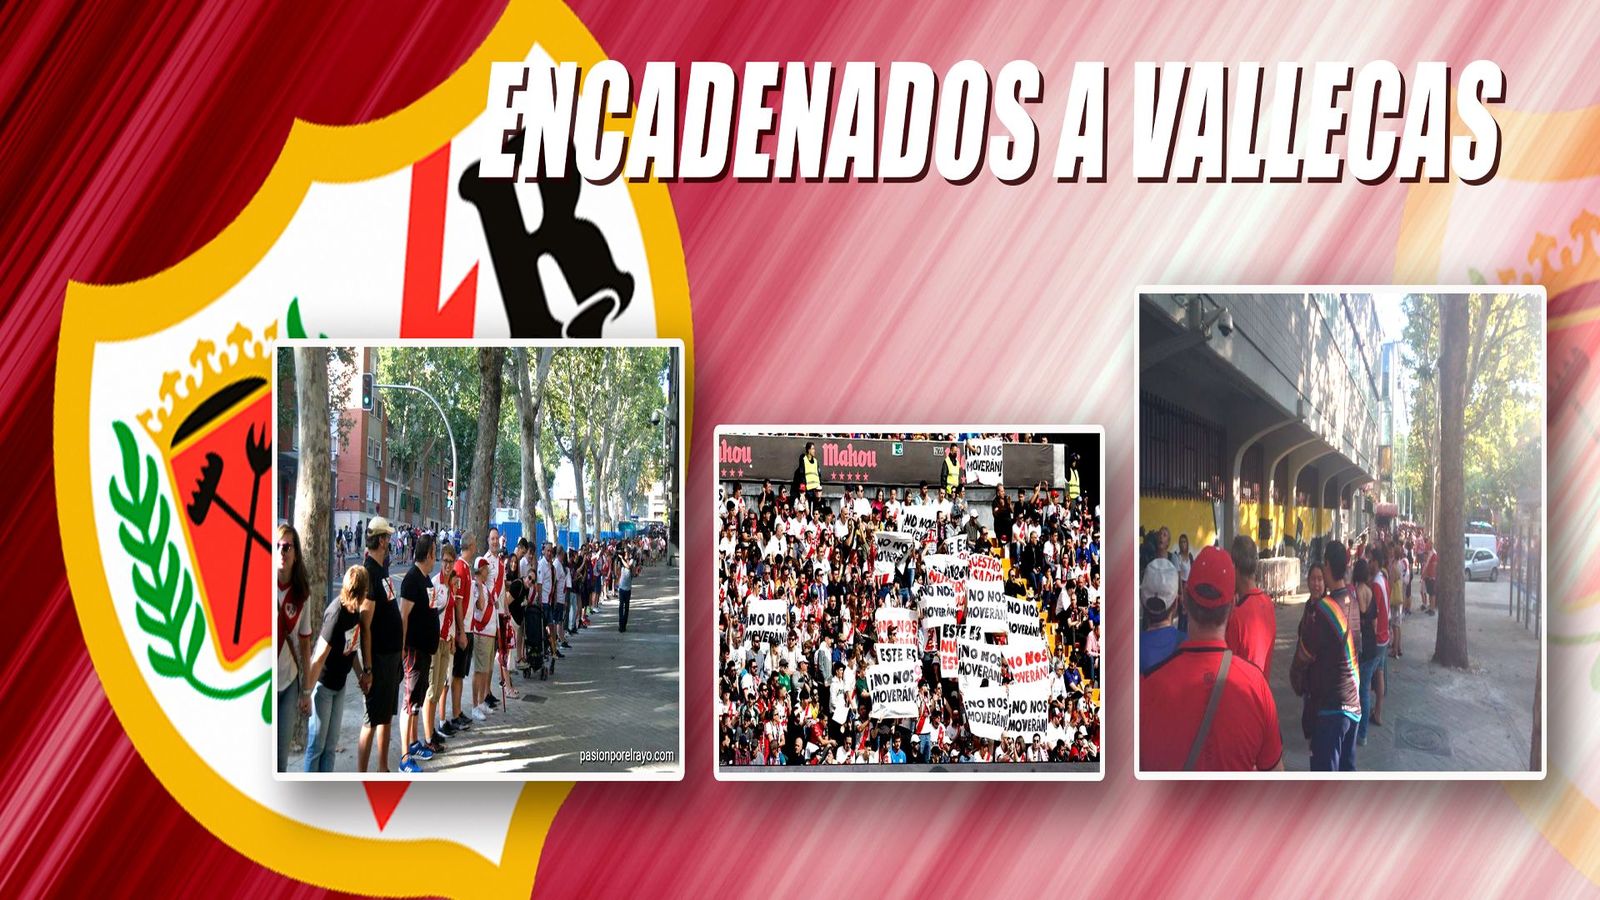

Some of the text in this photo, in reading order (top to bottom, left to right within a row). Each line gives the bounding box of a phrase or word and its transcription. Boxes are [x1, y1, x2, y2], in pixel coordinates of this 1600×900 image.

[822, 442, 877, 468] Mahou
[983, 445, 1002, 456] NOS
[987, 590, 1007, 603] NOS
[767, 612, 787, 626] NOS
[1022, 603, 1039, 618] NOS
[896, 619, 918, 636] NOS
[943, 623, 967, 640] ESTE
[879, 647, 917, 663] ESTE ES
[958, 643, 978, 661] ¡NO
[980, 651, 1002, 668] NOS
[1025, 649, 1048, 667] NOS
[869, 673, 891, 691] ¡NO
[892, 669, 914, 685] NOS
[964, 697, 1008, 711] ¡NO NOS
[1009, 699, 1048, 719] ¡NO NOS
